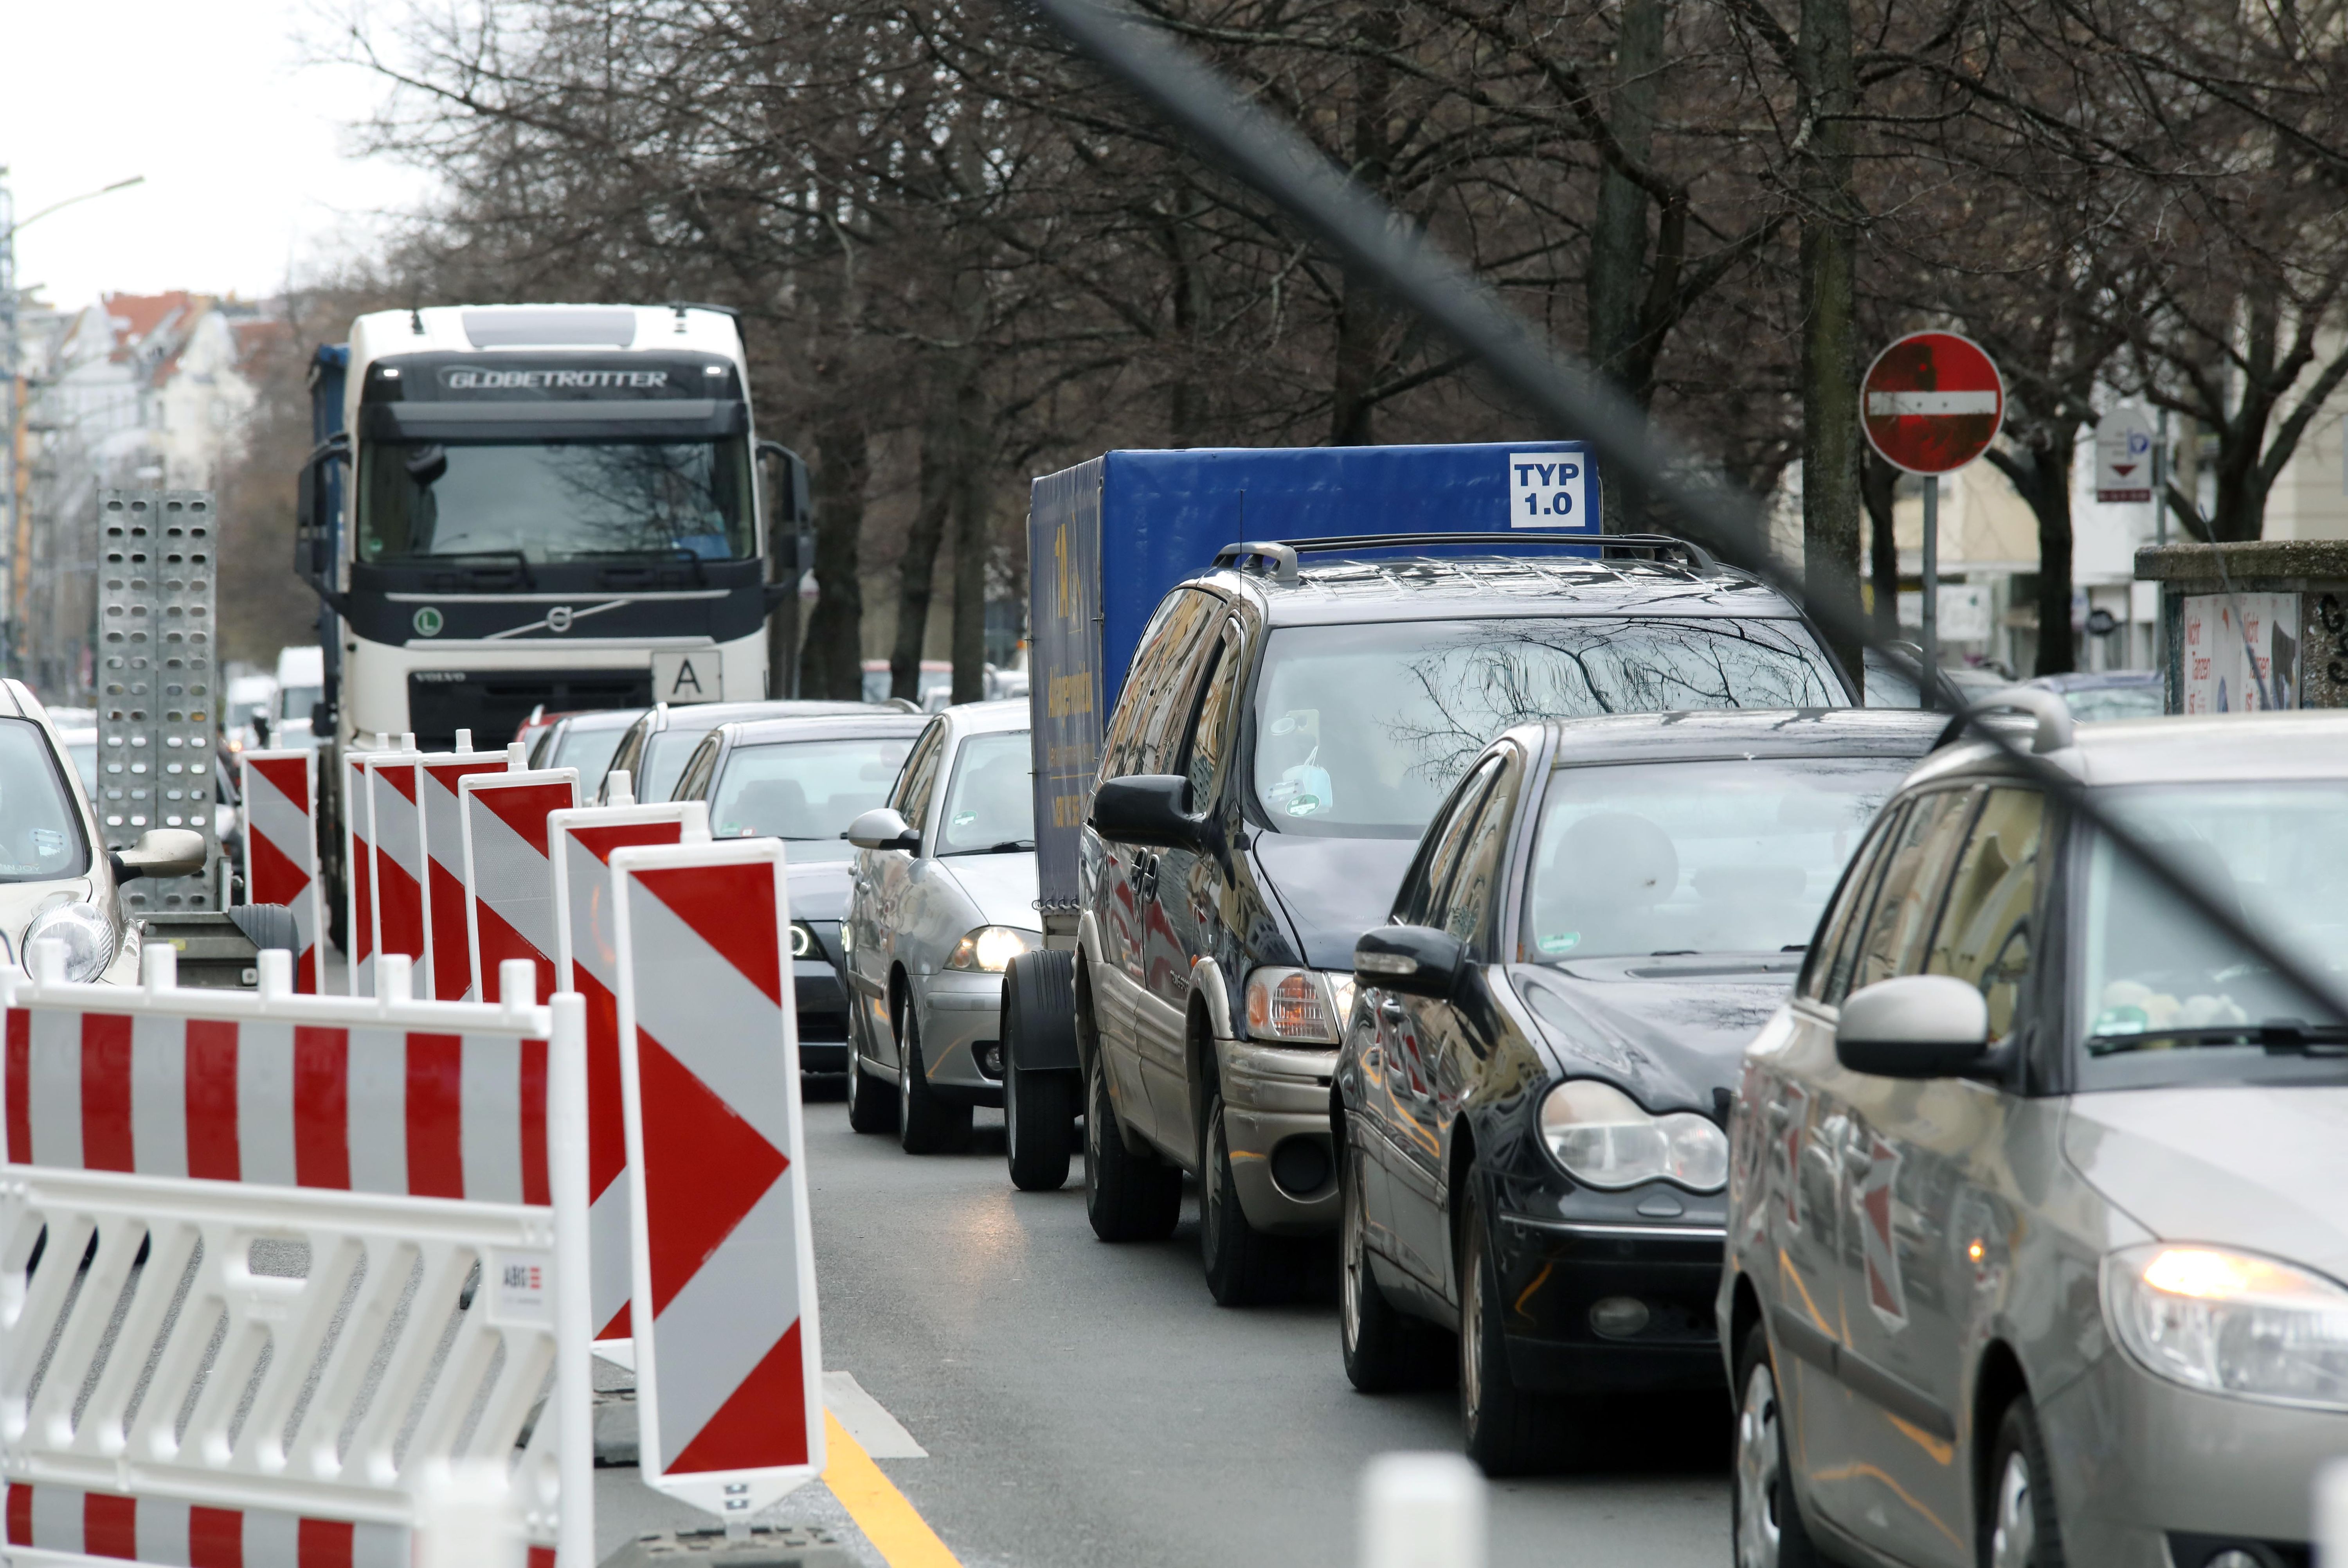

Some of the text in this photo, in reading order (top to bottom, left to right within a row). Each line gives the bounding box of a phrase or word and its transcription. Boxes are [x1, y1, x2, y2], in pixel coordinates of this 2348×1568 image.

[450, 370, 668, 389] GLOBETROTTER
[1514, 463, 1579, 486] TYP
[1525, 491, 1572, 515] 1.0
[422, 612, 438, 631] L
[415, 672, 466, 682] VOLVO
[672, 658, 702, 694] A
